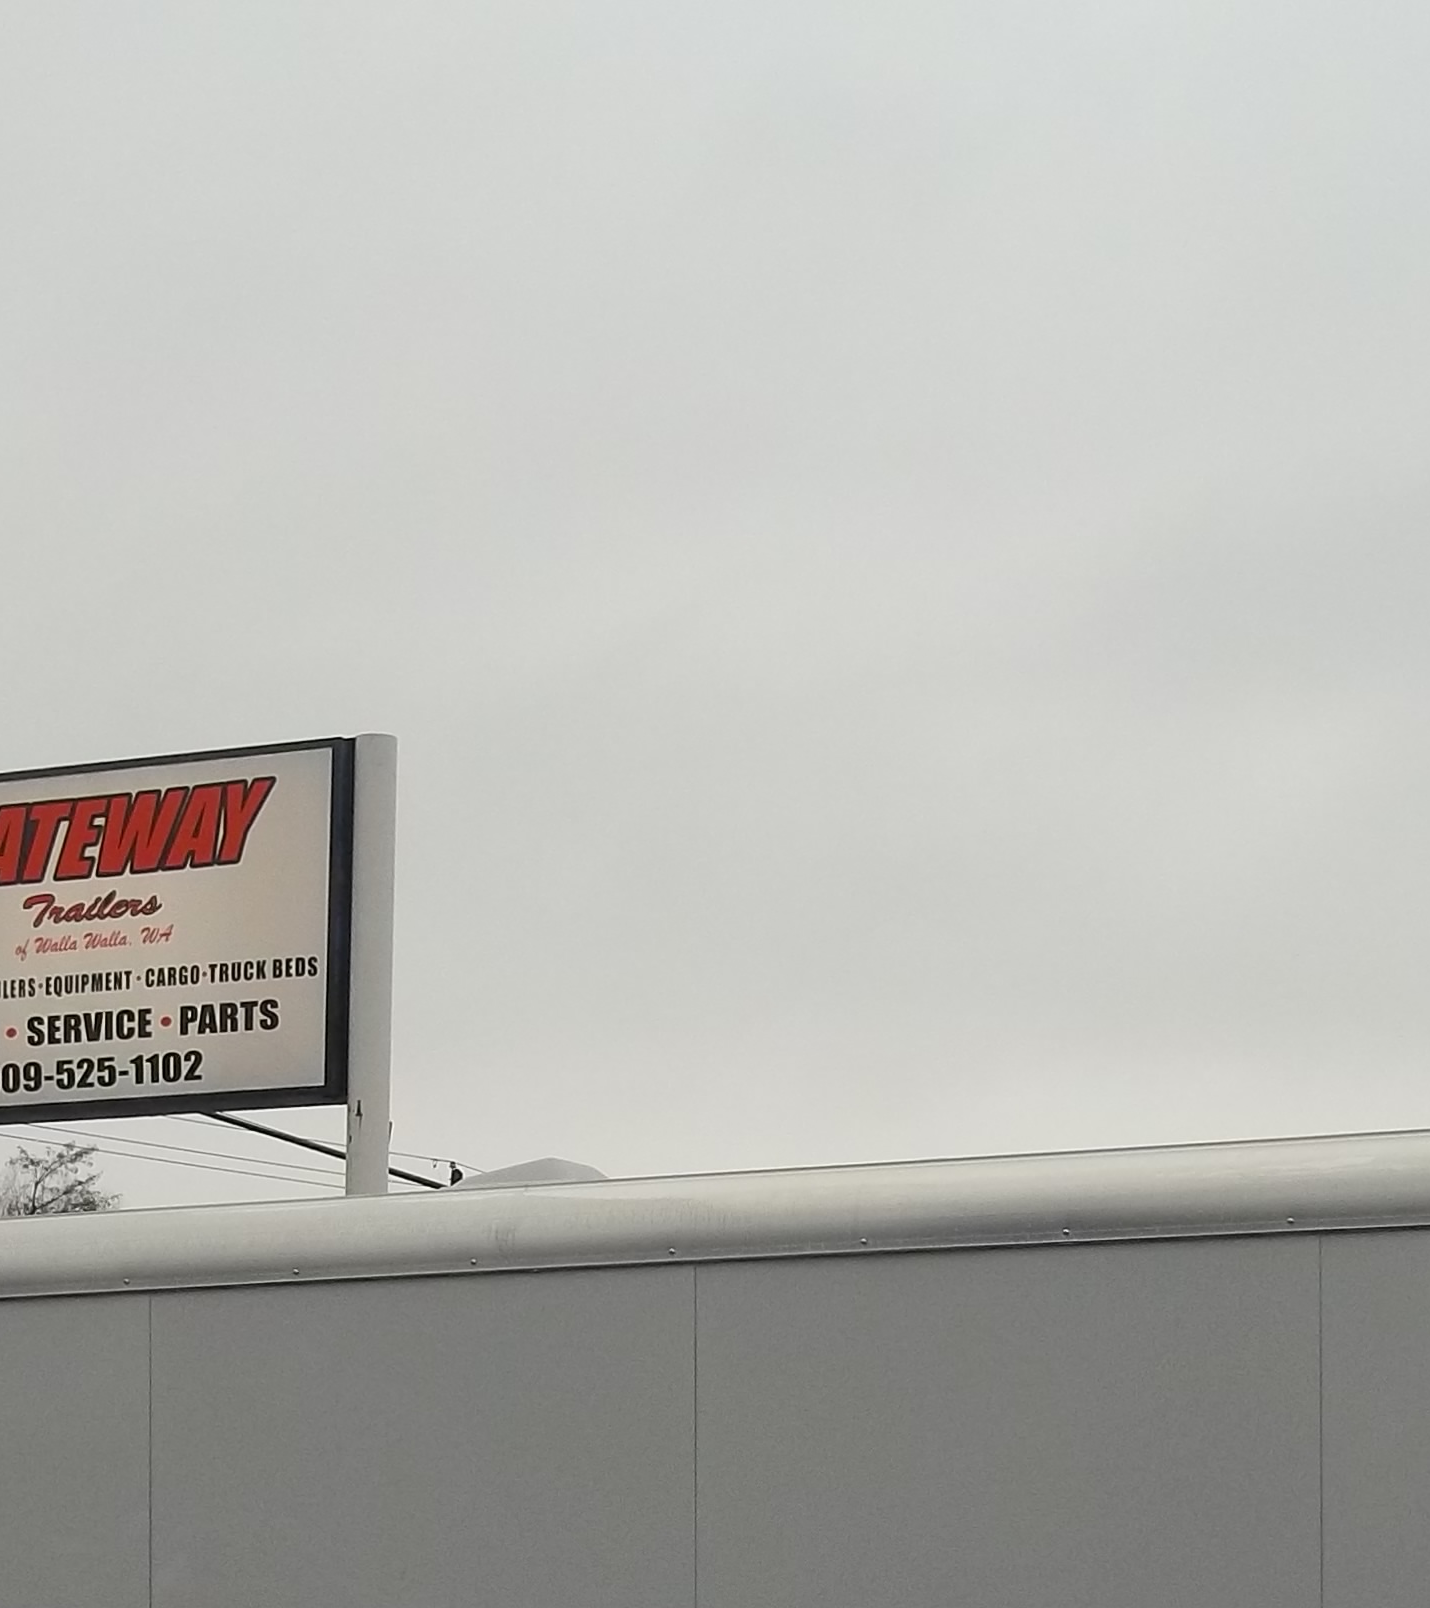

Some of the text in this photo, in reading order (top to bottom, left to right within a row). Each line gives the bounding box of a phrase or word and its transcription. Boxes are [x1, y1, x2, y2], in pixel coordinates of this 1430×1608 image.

[22, 890, 163, 929] Trailers
[14, 939, 30, 962] of
[35, 935, 77, 954] Walla
[141, 924, 174, 944] WA
[45, 970, 132, 996] EQUIPMENT
[145, 965, 200, 988] CARGO
[209, 960, 267, 984] TRUCK
[272, 957, 319, 979] BEDS
[26, 1008, 153, 1046] SERVICE
[179, 999, 280, 1035] PARTS
